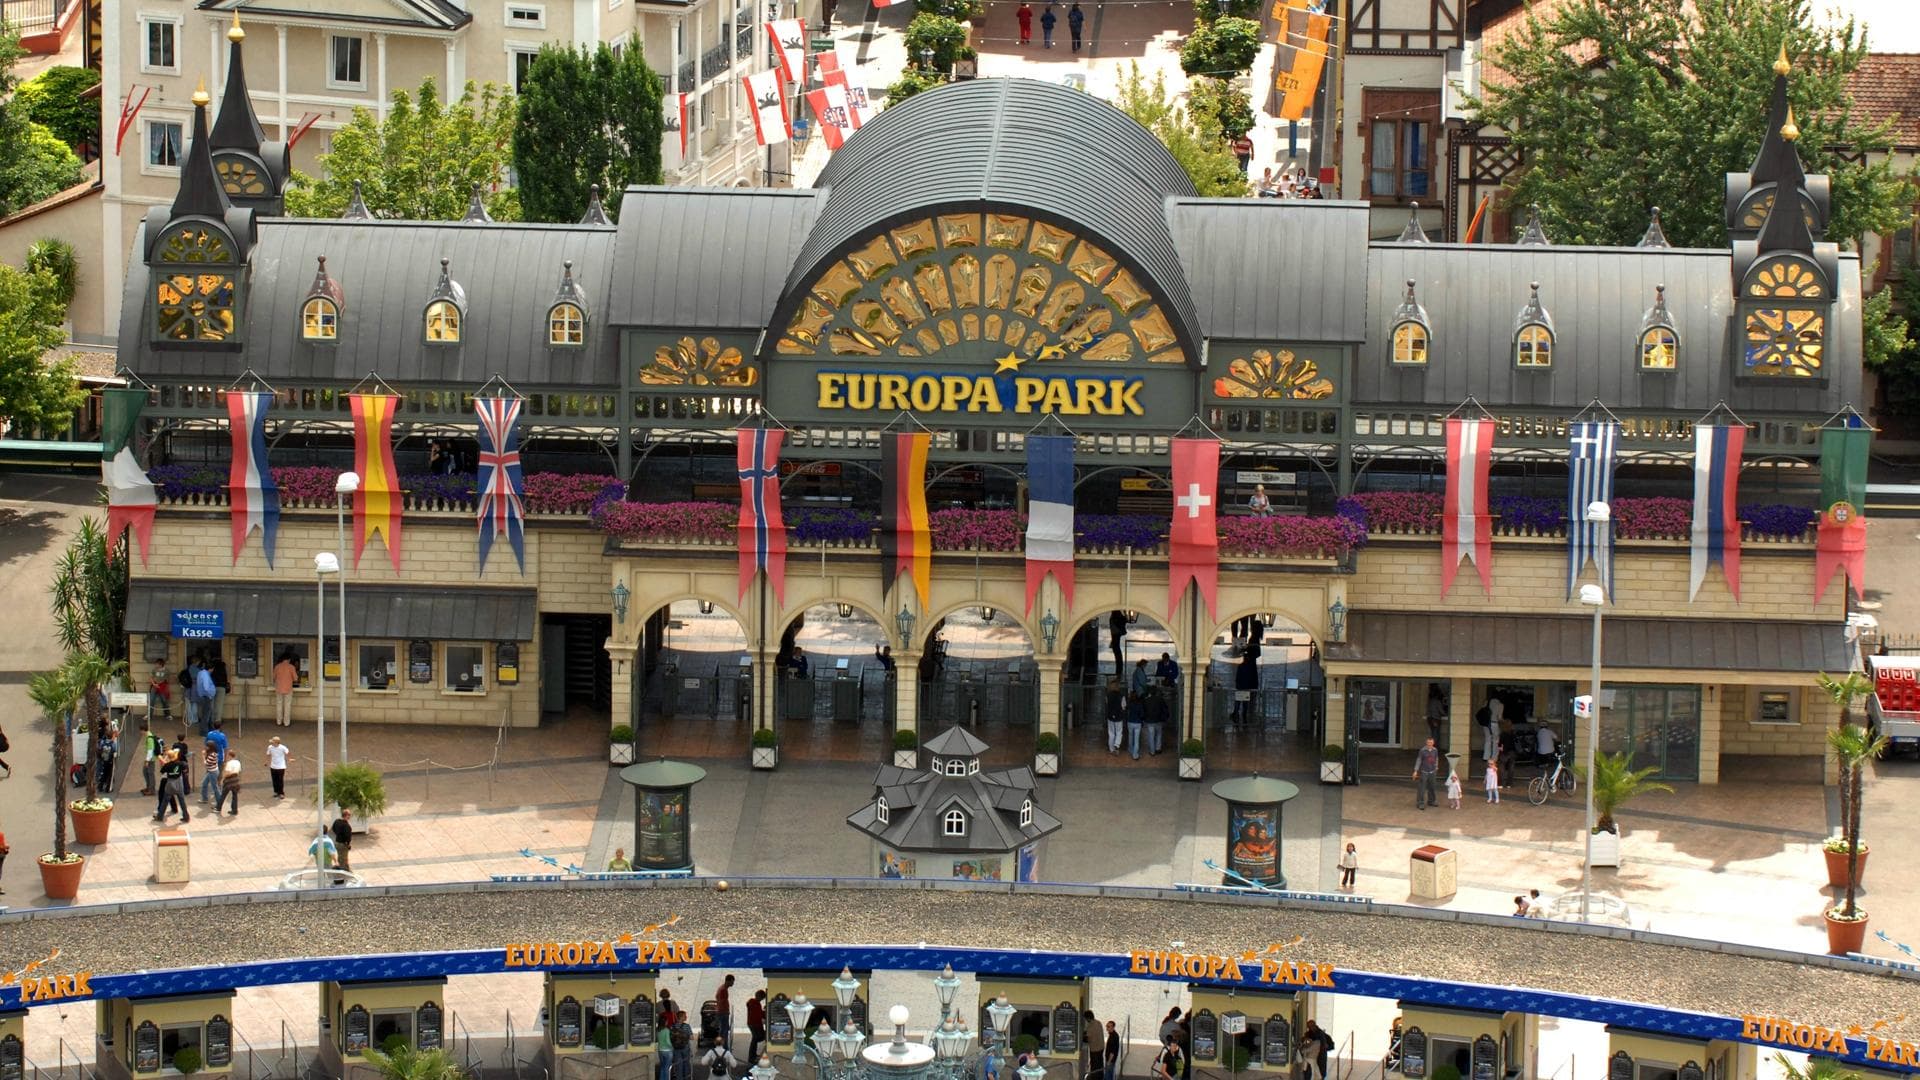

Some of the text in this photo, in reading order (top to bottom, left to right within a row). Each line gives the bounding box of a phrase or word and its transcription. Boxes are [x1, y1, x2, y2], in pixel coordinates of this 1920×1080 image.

[816, 371, 1145, 416] EUROPA PARK
[182, 627, 213, 638] Kasse
[504, 939, 713, 967] EUROPA PARK
[1129, 948, 1336, 988] EUROPA PARK
[19, 970, 94, 1003] PARK
[1741, 1014, 1920, 1067] EUROPA PAR
